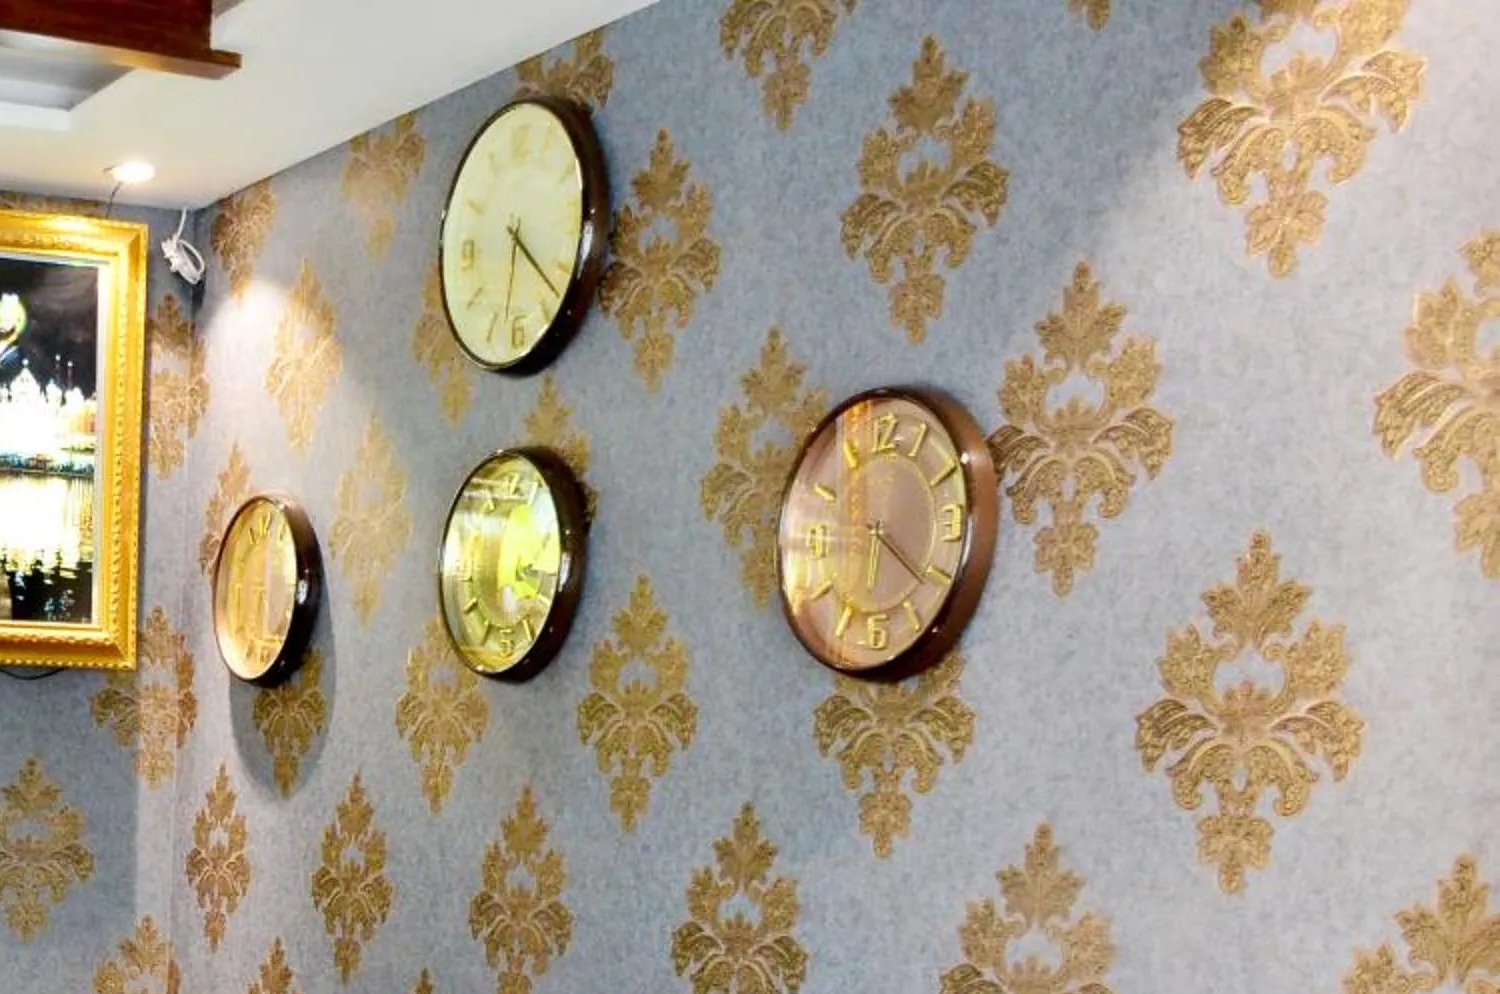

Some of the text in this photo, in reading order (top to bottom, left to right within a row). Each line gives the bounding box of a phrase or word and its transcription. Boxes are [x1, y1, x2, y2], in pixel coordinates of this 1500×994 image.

[871, 412, 897, 452] 12
[941, 502, 964, 543] 3
[866, 613, 889, 650] 6
